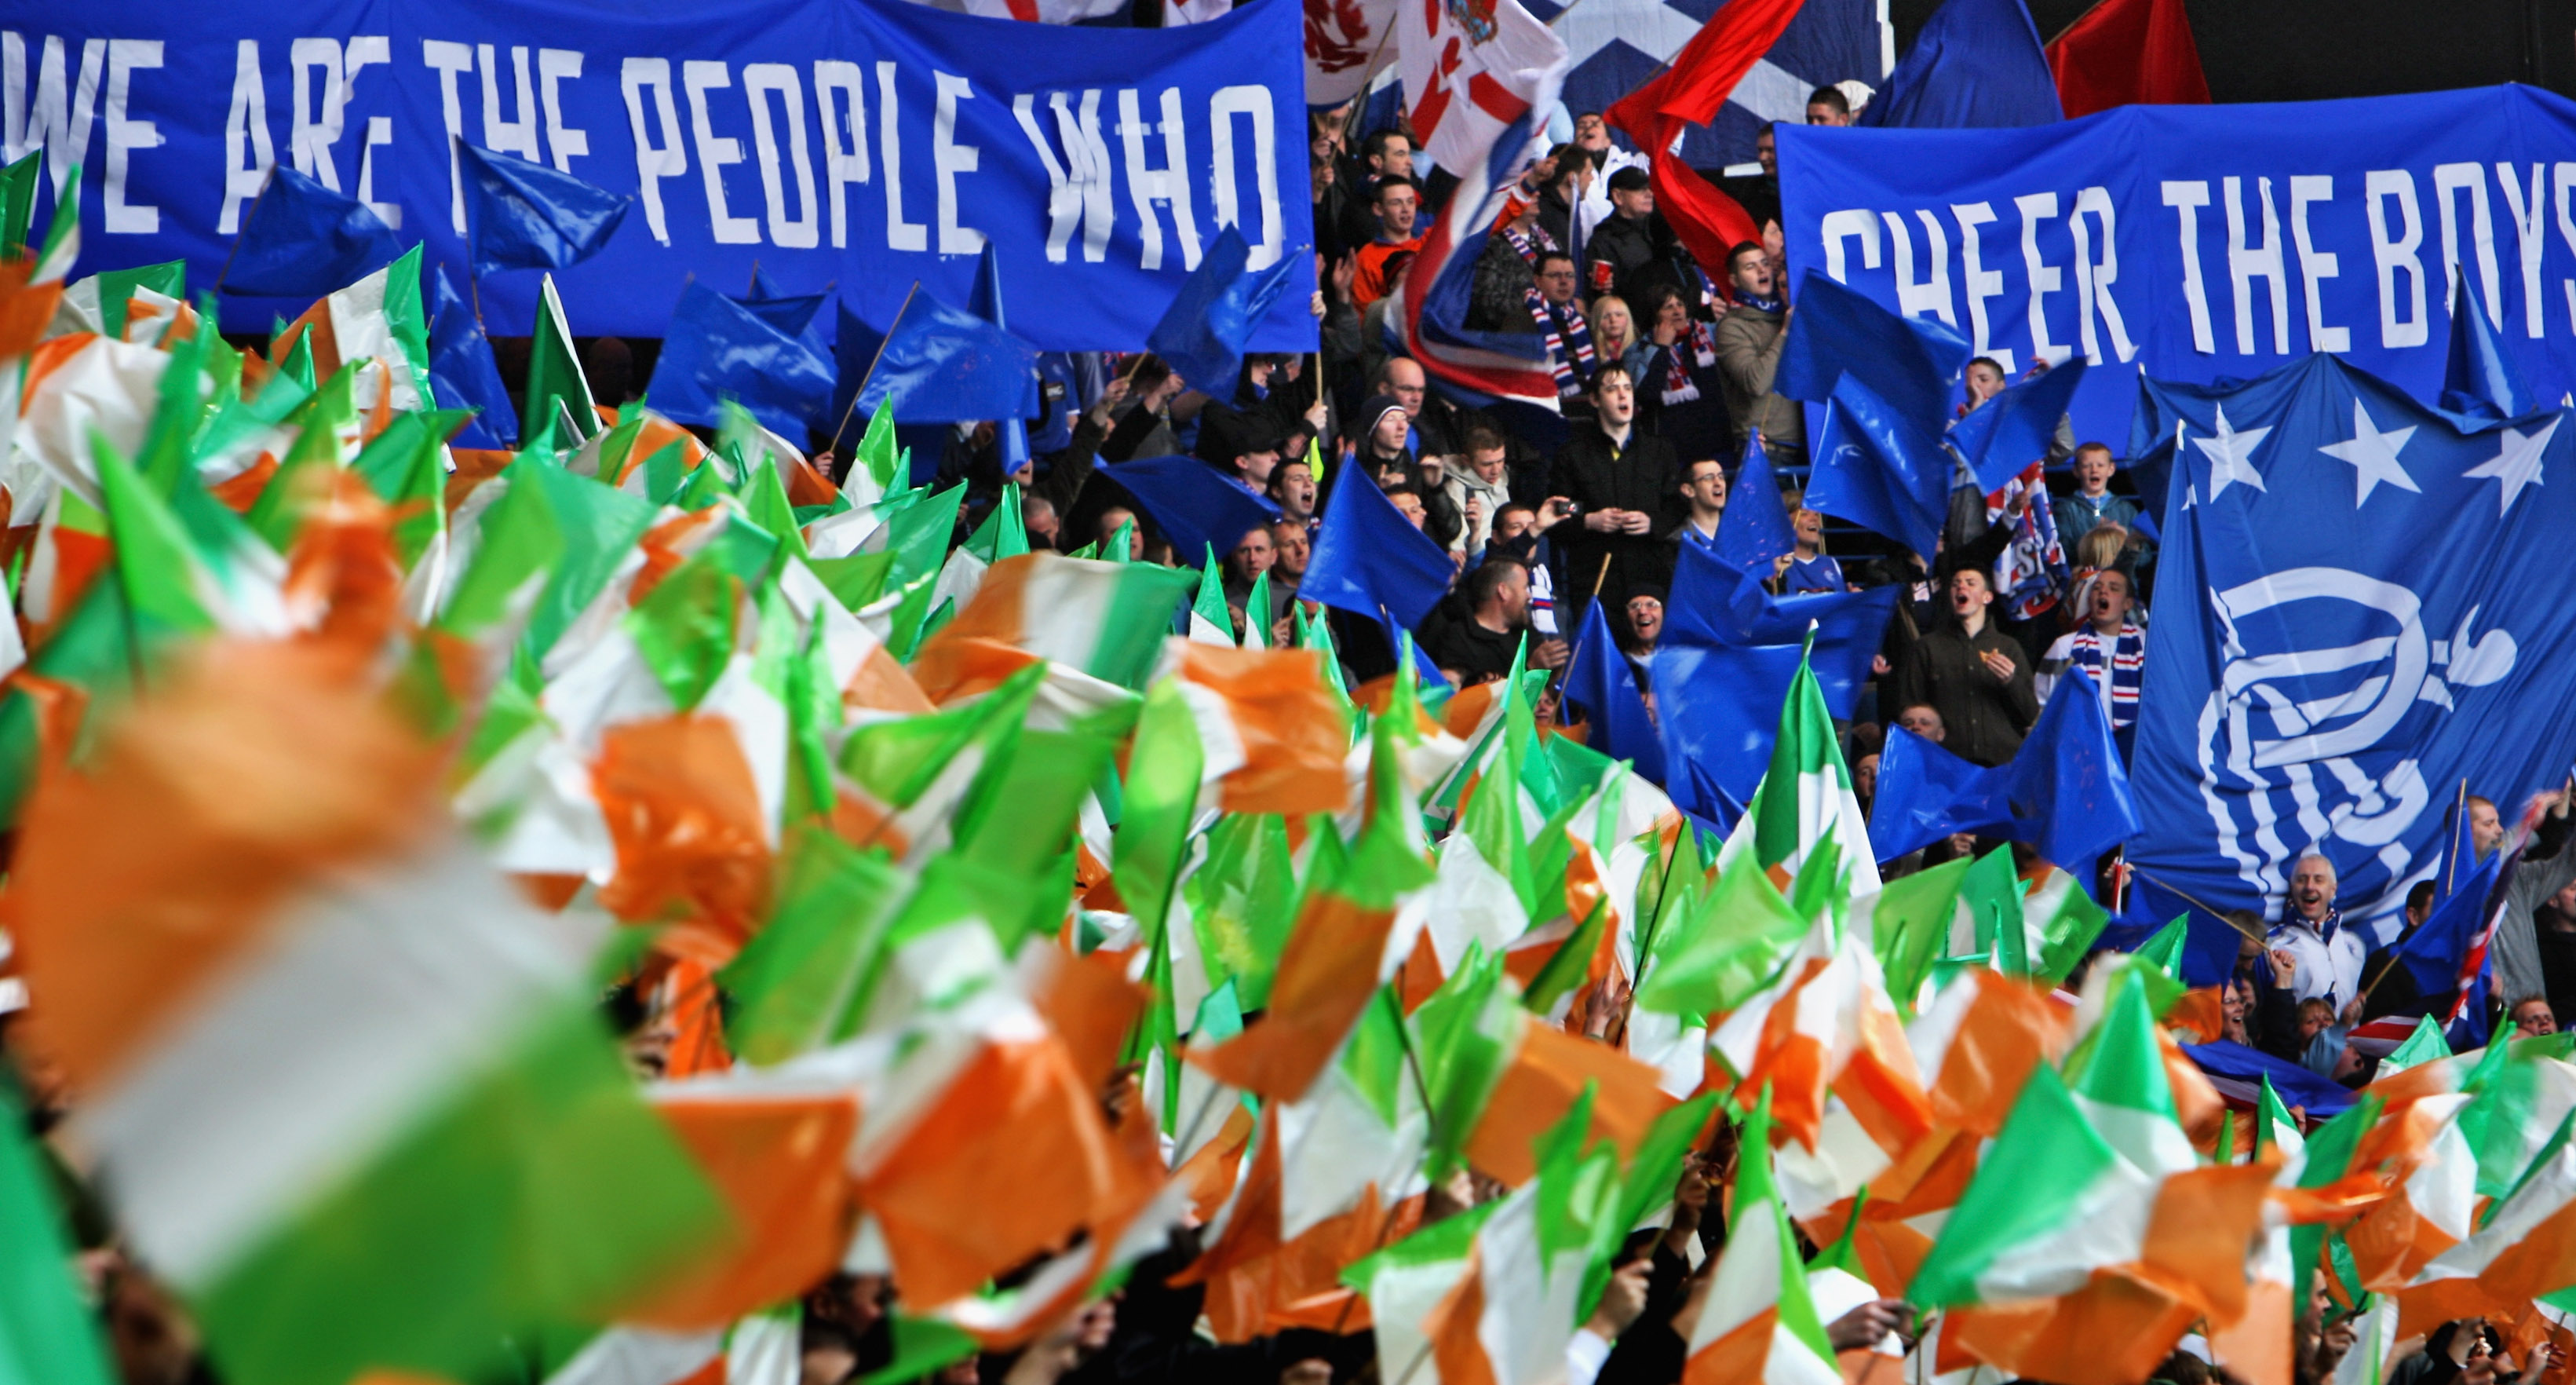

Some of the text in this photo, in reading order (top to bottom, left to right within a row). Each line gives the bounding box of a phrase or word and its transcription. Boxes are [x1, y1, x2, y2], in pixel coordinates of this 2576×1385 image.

[2, 31, 1284, 272] WE ARE THE PEOPLE WHO
[2161, 175, 2351, 355] THE
